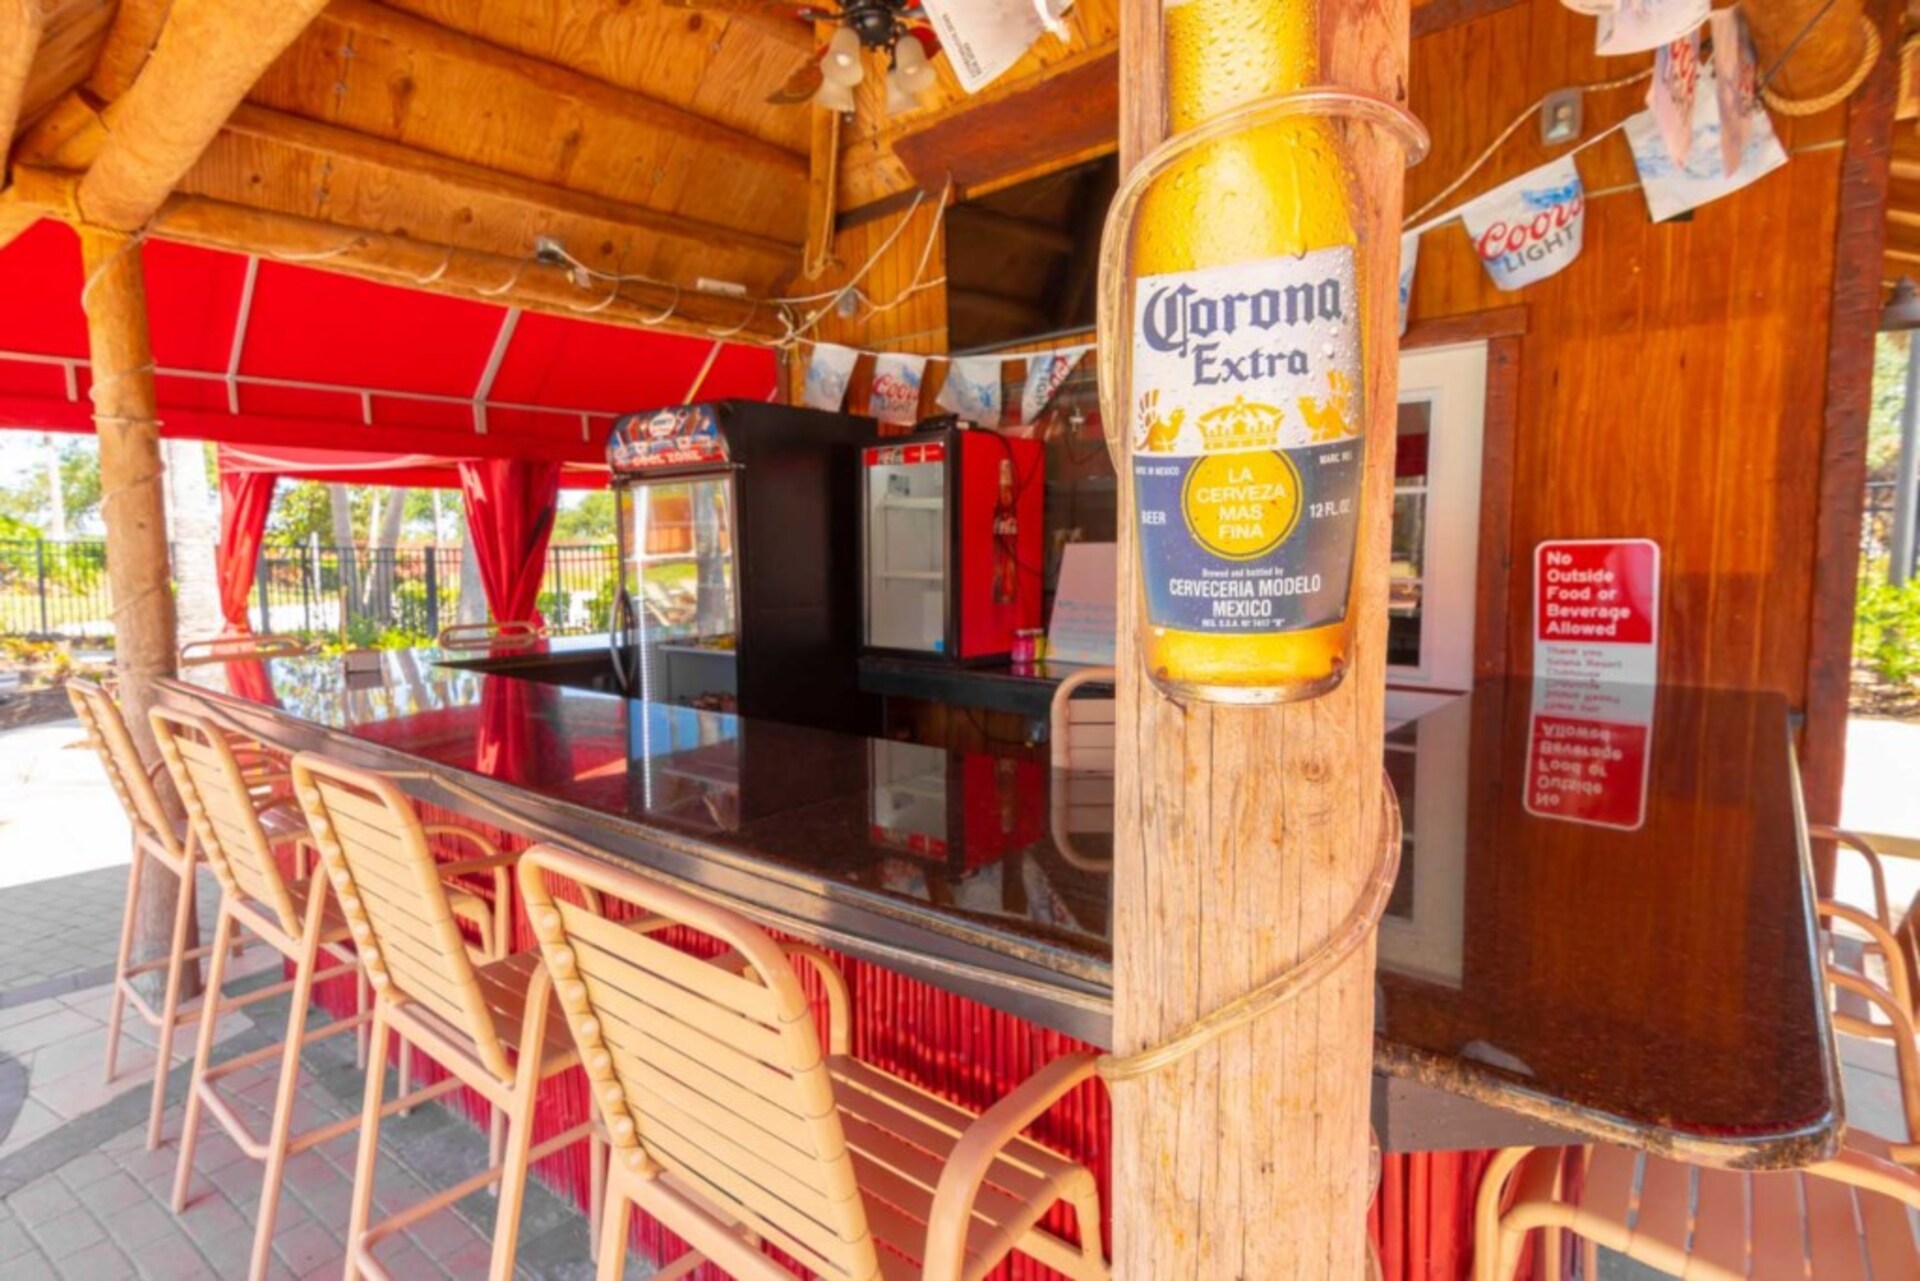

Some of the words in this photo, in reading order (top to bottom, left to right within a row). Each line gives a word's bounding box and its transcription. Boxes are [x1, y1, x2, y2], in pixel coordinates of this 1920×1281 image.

[1504, 226, 1575, 274] LIGHT
[1142, 278, 1342, 358] Corona
[1192, 341, 1310, 386] Extra
[1228, 467, 1254, 484] LA
[1197, 485, 1288, 504] CERVEZA
[1141, 510, 1167, 525] BEER
[1218, 506, 1263, 521] MAS
[1309, 503, 1323, 519] 12
[1218, 524, 1265, 540] FINA
[1546, 551, 1572, 565] No
[1201, 568, 1229, 578] Brewed
[1231, 568, 1244, 578] and
[1546, 569, 1614, 583] Outside
[1169, 578, 1255, 597] CERVECERIA
[1259, 574, 1321, 597] MODELO
[1546, 586, 1591, 600] Food
[1597, 588, 1617, 600] or
[1212, 600, 1272, 617] MEXICO
[1546, 603, 1631, 622] Beverage
[1546, 621, 1617, 636] Allowed
